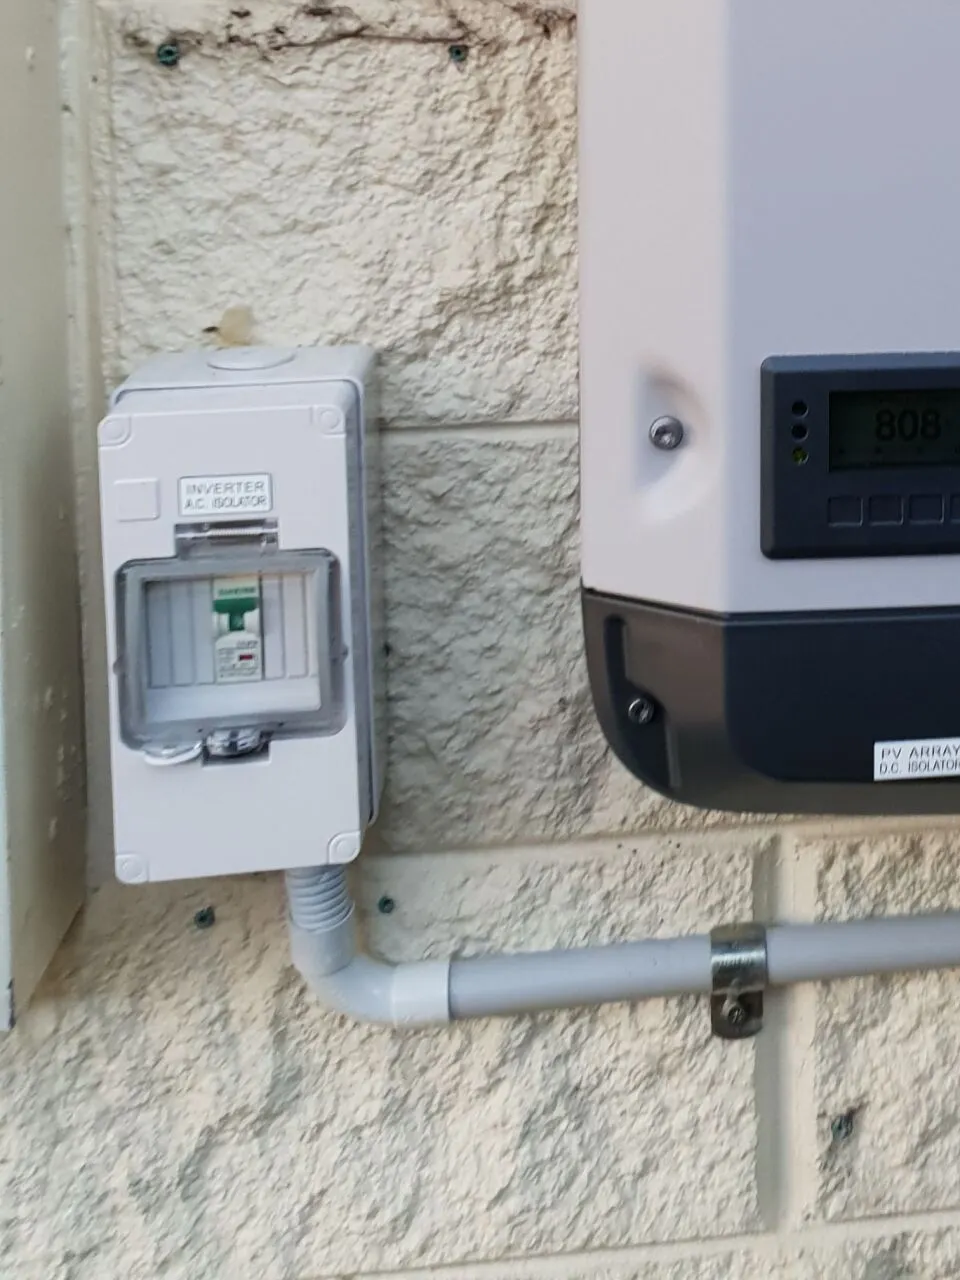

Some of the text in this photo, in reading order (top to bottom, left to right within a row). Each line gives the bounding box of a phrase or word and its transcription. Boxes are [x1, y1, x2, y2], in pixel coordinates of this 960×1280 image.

[874, 408, 943, 441] 808
[186, 480, 265, 495] INVERTER
[881, 747, 902, 760] PV
